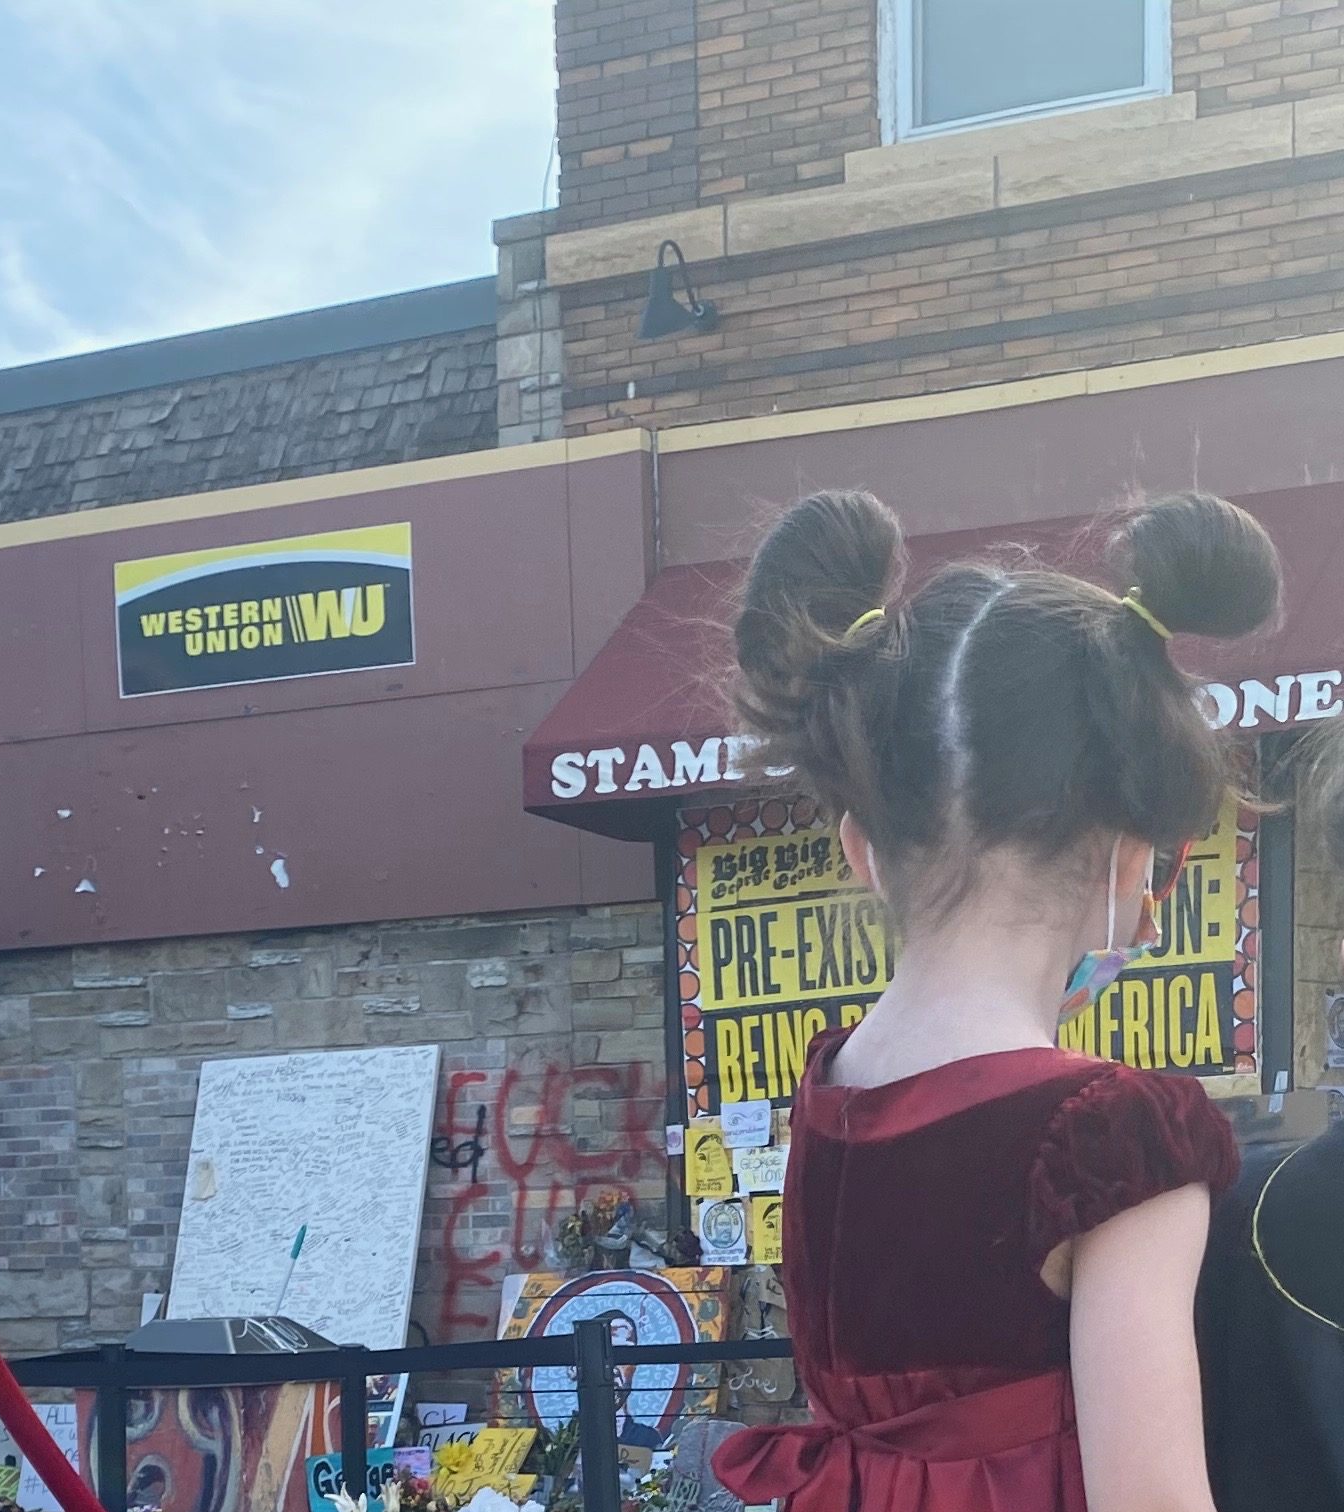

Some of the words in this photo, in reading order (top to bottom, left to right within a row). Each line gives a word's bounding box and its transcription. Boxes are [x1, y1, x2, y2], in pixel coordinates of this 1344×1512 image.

[139, 598, 283, 638] WESTERN
[296, 583, 386, 642] WU
[184, 622, 283, 657] UNION
[551, 734, 796, 798] STAMP
[711, 844, 769, 884] Big
[773, 836, 832, 873] Big
[716, 1008, 827, 1104] BEIN
[729, 1368, 777, 1394] Love
[312, 1459, 395, 1501] Gege
